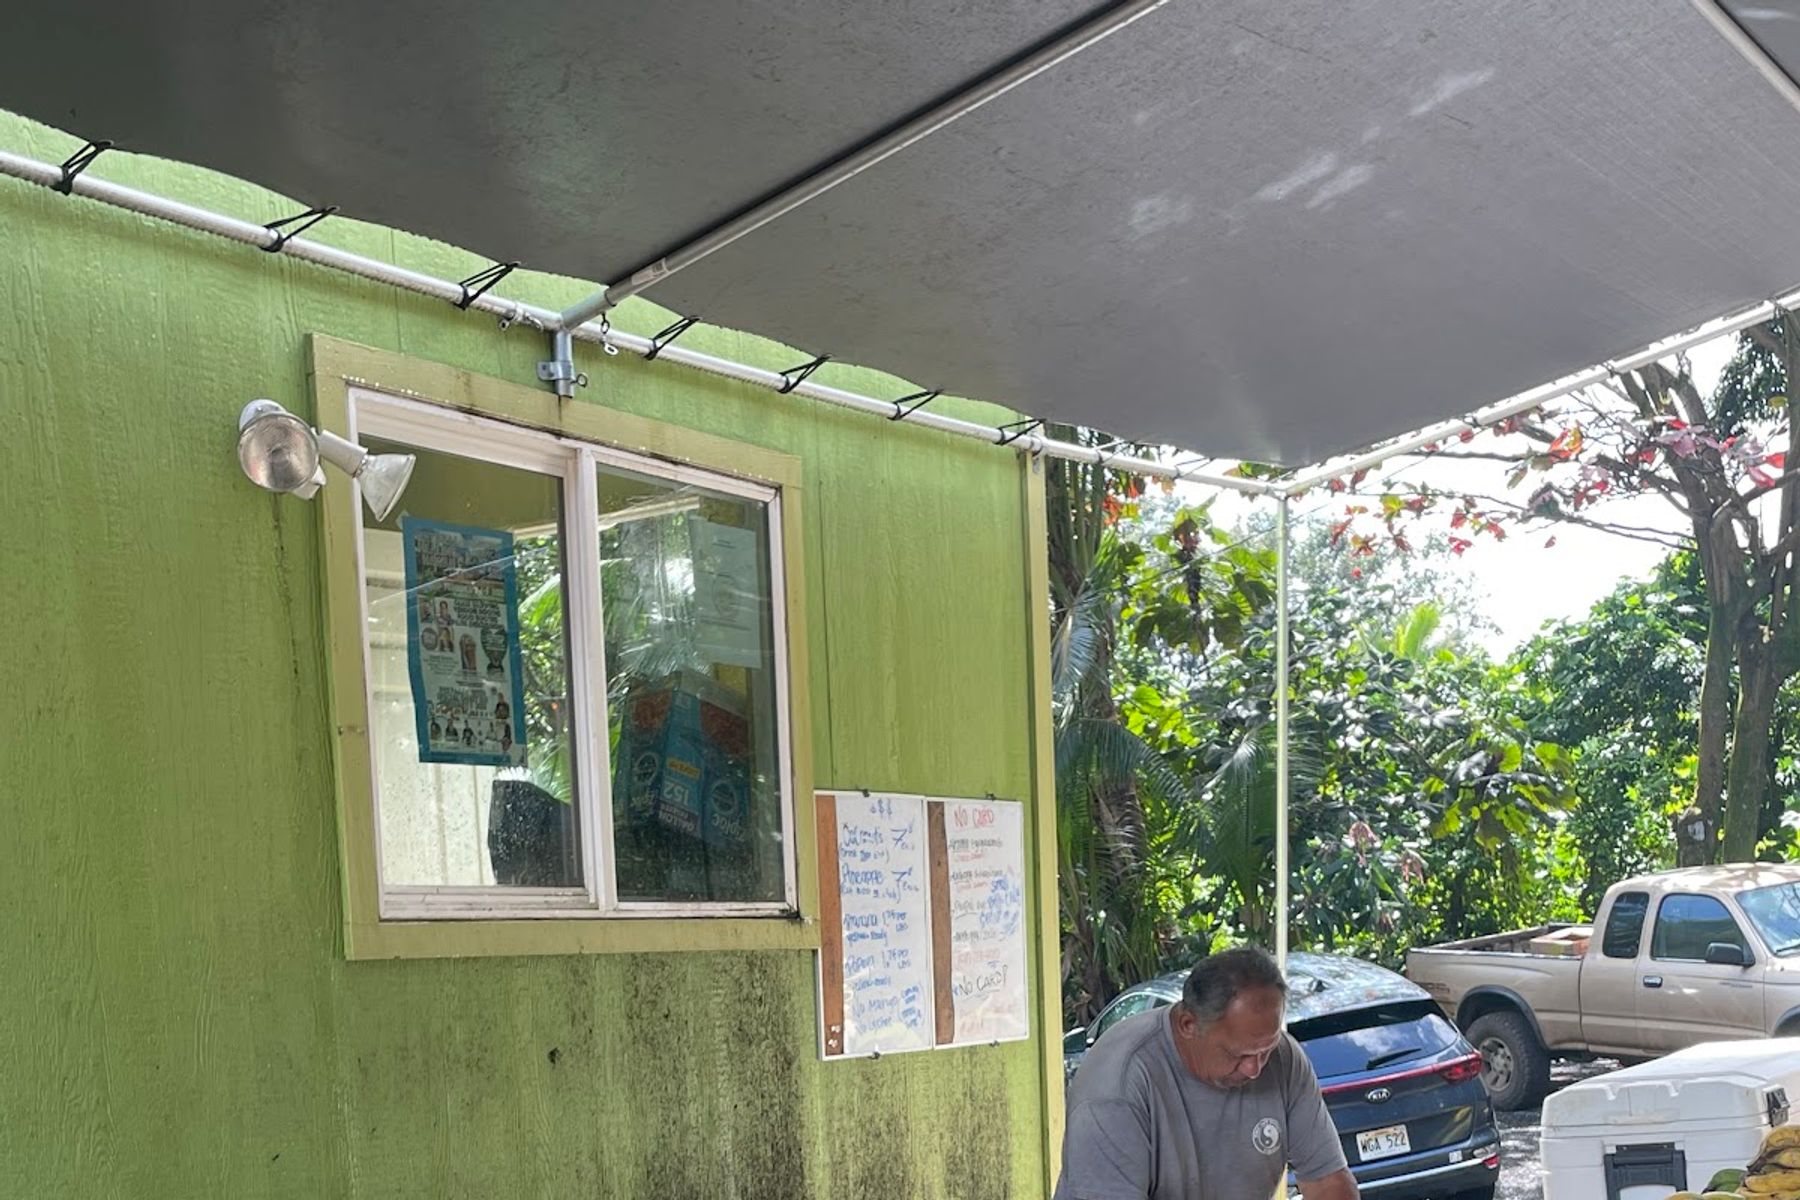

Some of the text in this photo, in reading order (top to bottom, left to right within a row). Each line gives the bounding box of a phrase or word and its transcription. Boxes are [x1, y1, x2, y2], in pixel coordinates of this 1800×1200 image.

[663, 782, 689, 806] 152
[658, 810, 695, 832] GALLON
[954, 806, 968, 828] NO
[1360, 1136, 1382, 1153] WGA
[1386, 1131, 1407, 1149] 522
